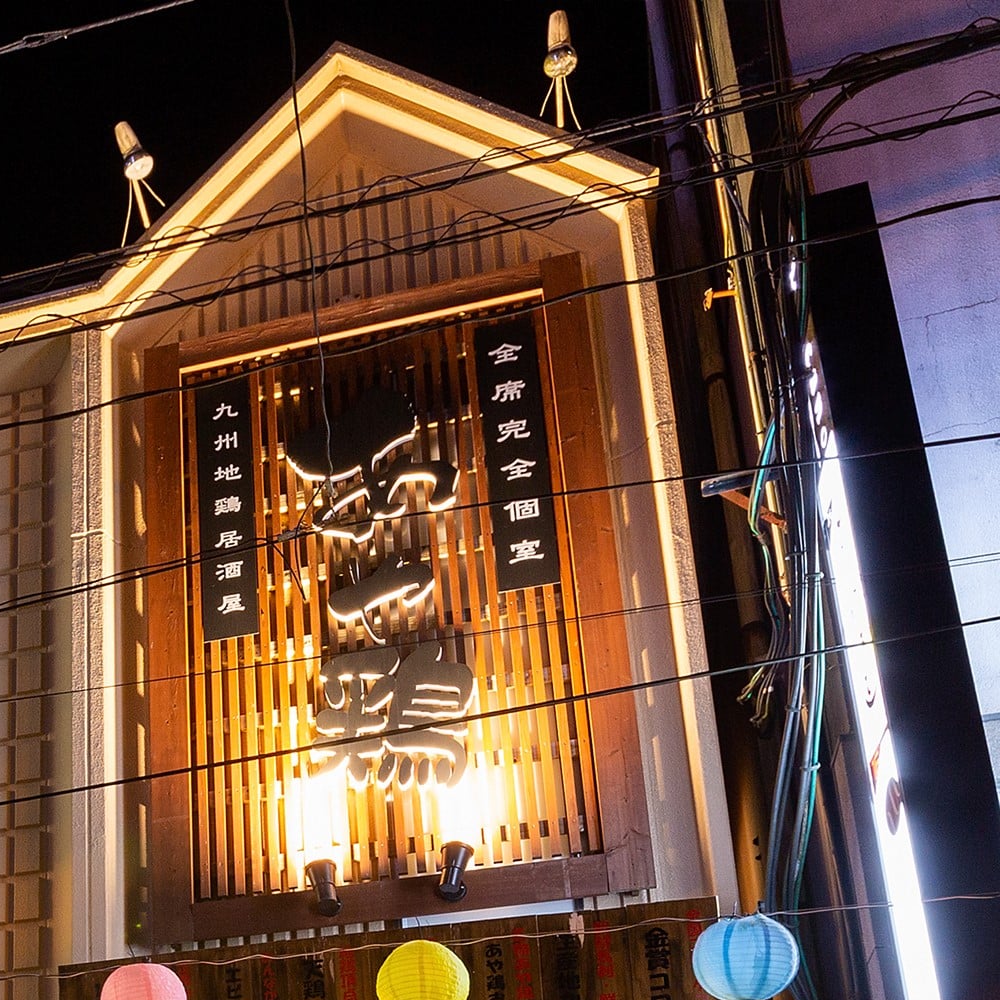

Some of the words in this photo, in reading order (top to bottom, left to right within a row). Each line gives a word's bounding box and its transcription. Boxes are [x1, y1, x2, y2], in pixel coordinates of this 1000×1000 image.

[212, 402, 246, 616] 九州地鶏居酒屋
[487, 342, 546, 565] 全席完全個室
